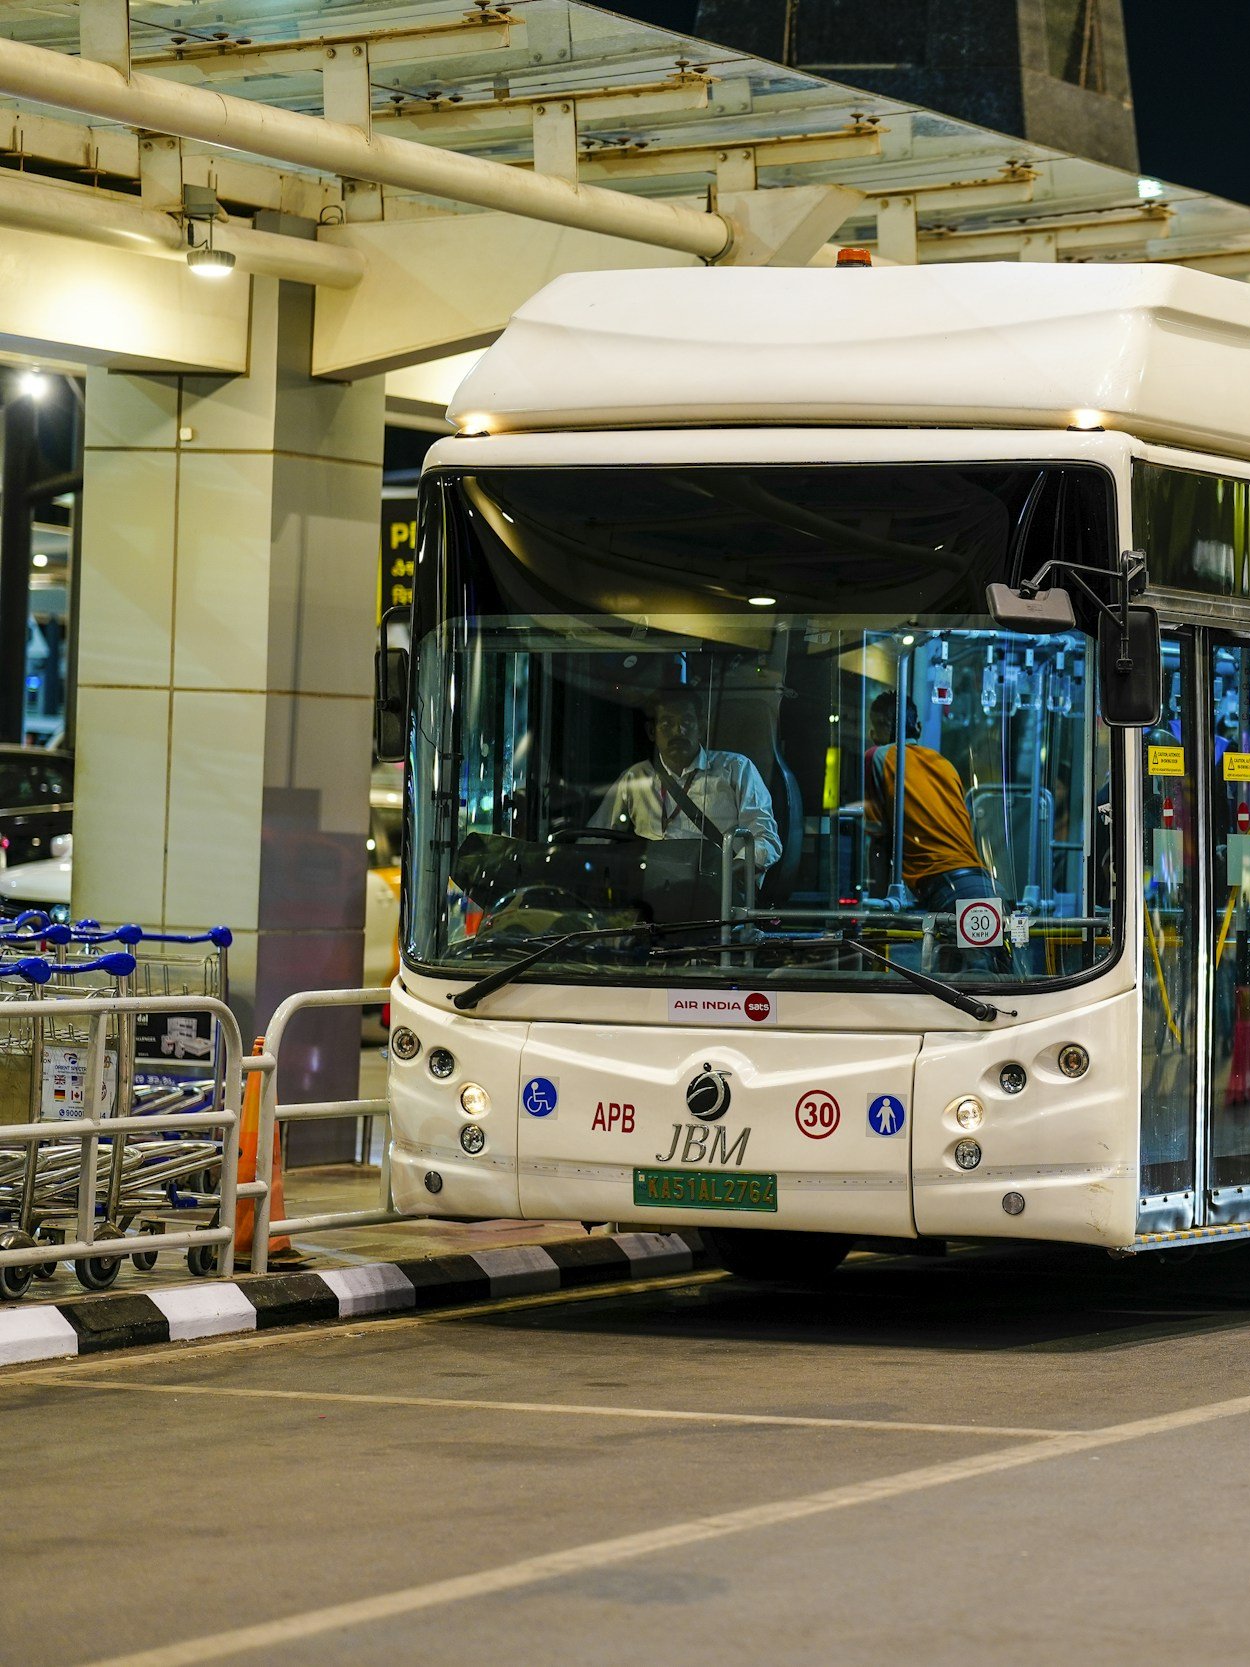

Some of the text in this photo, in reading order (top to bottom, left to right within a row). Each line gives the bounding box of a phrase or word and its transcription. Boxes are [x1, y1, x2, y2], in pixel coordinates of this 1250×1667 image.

[970, 915, 990, 931] 30
[674, 1000, 770, 1011] AIR INDIA sats
[591, 1101, 636, 1134] APB
[803, 1102, 834, 1128] 30
[655, 1123, 752, 1166] JBM
[647, 1175, 774, 1204] KA51AL2764
